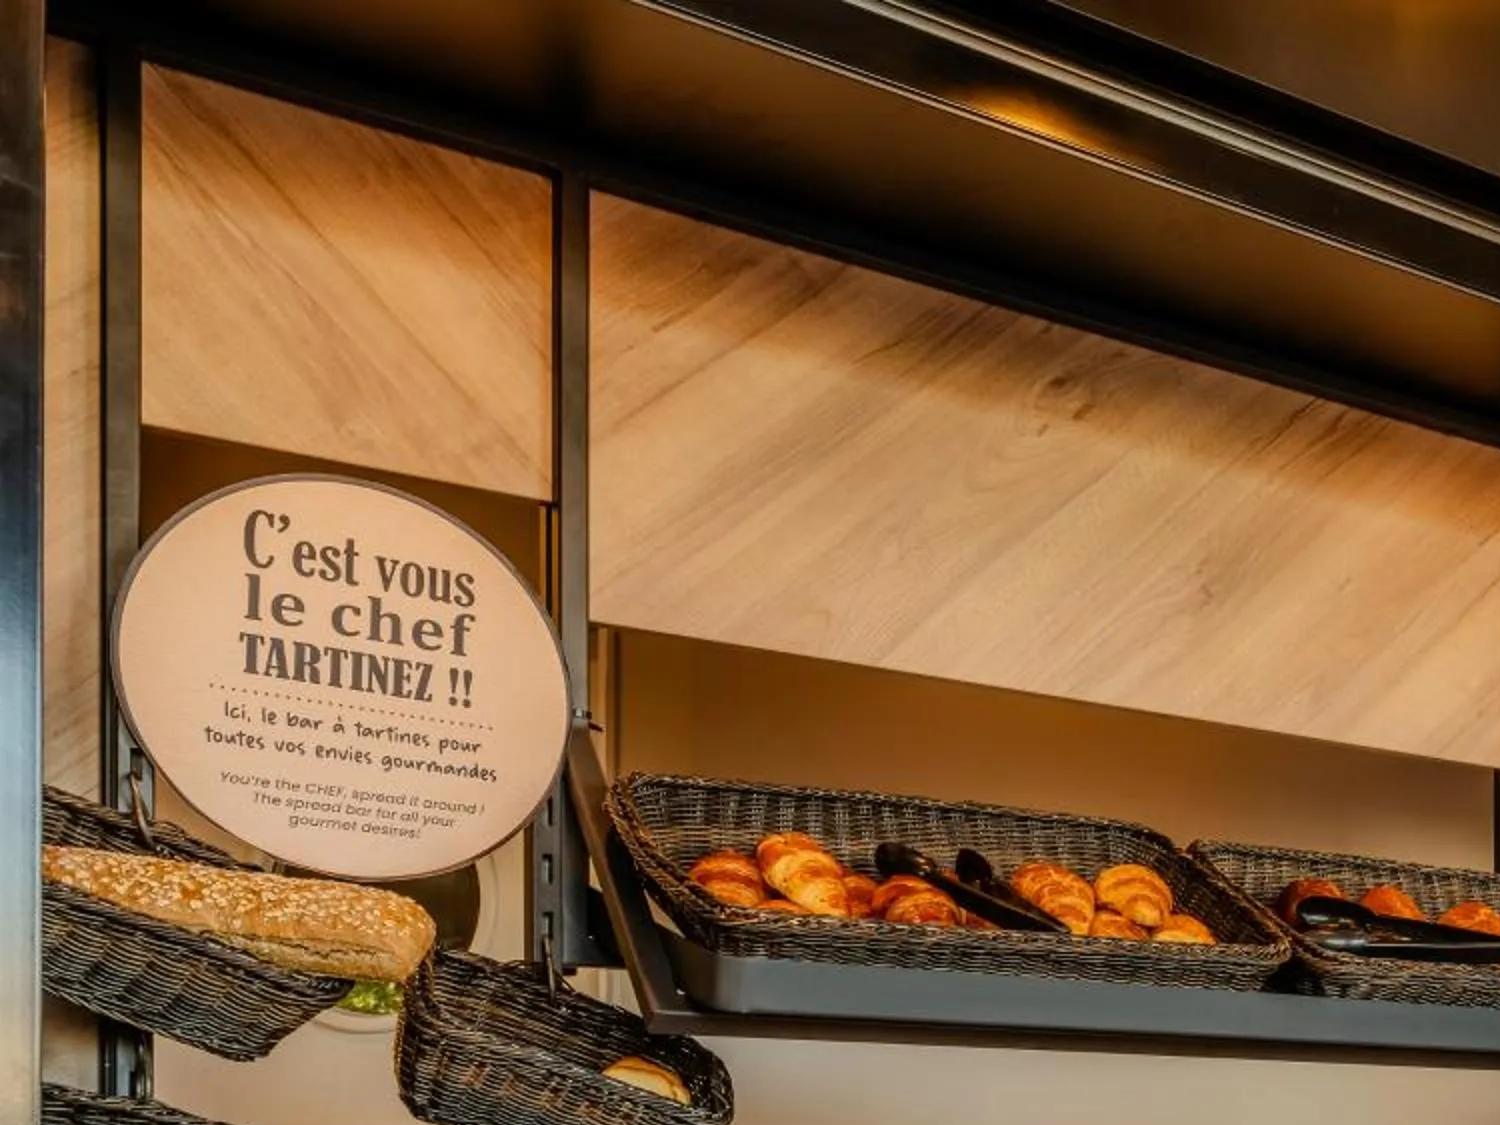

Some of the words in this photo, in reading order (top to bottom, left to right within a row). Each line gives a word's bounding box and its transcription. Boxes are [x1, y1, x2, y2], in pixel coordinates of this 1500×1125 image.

[244, 510, 359, 586] C'est
[375, 555, 475, 607] vous
[244, 573, 305, 626] le
[331, 596, 476, 656] chef
[239, 632, 433, 702] TARTINEZ
[448, 667, 473, 708] !!
[205, 725, 265, 750] toutes
[274, 739, 306, 756] vos
[315, 744, 372, 765] envies
[381, 754, 497, 783] gourmandes
[261, 707, 277, 725] le
[287, 712, 323, 730] bar
[333, 716, 345, 735] à
[353, 721, 430, 748] tartines
[439, 738, 482, 755] pour
[254, 792, 281, 806] The
[286, 798, 342, 815] spread
[345, 803, 372, 816] bar
[375, 805, 397, 819] for
[400, 809, 419, 822] all
[422, 813, 455, 828] your
[275, 779, 300, 792] the
[352, 790, 405, 808] spread
[409, 795, 419, 807] it
[423, 799, 477, 814] around
[288, 813, 357, 831] gourmet
